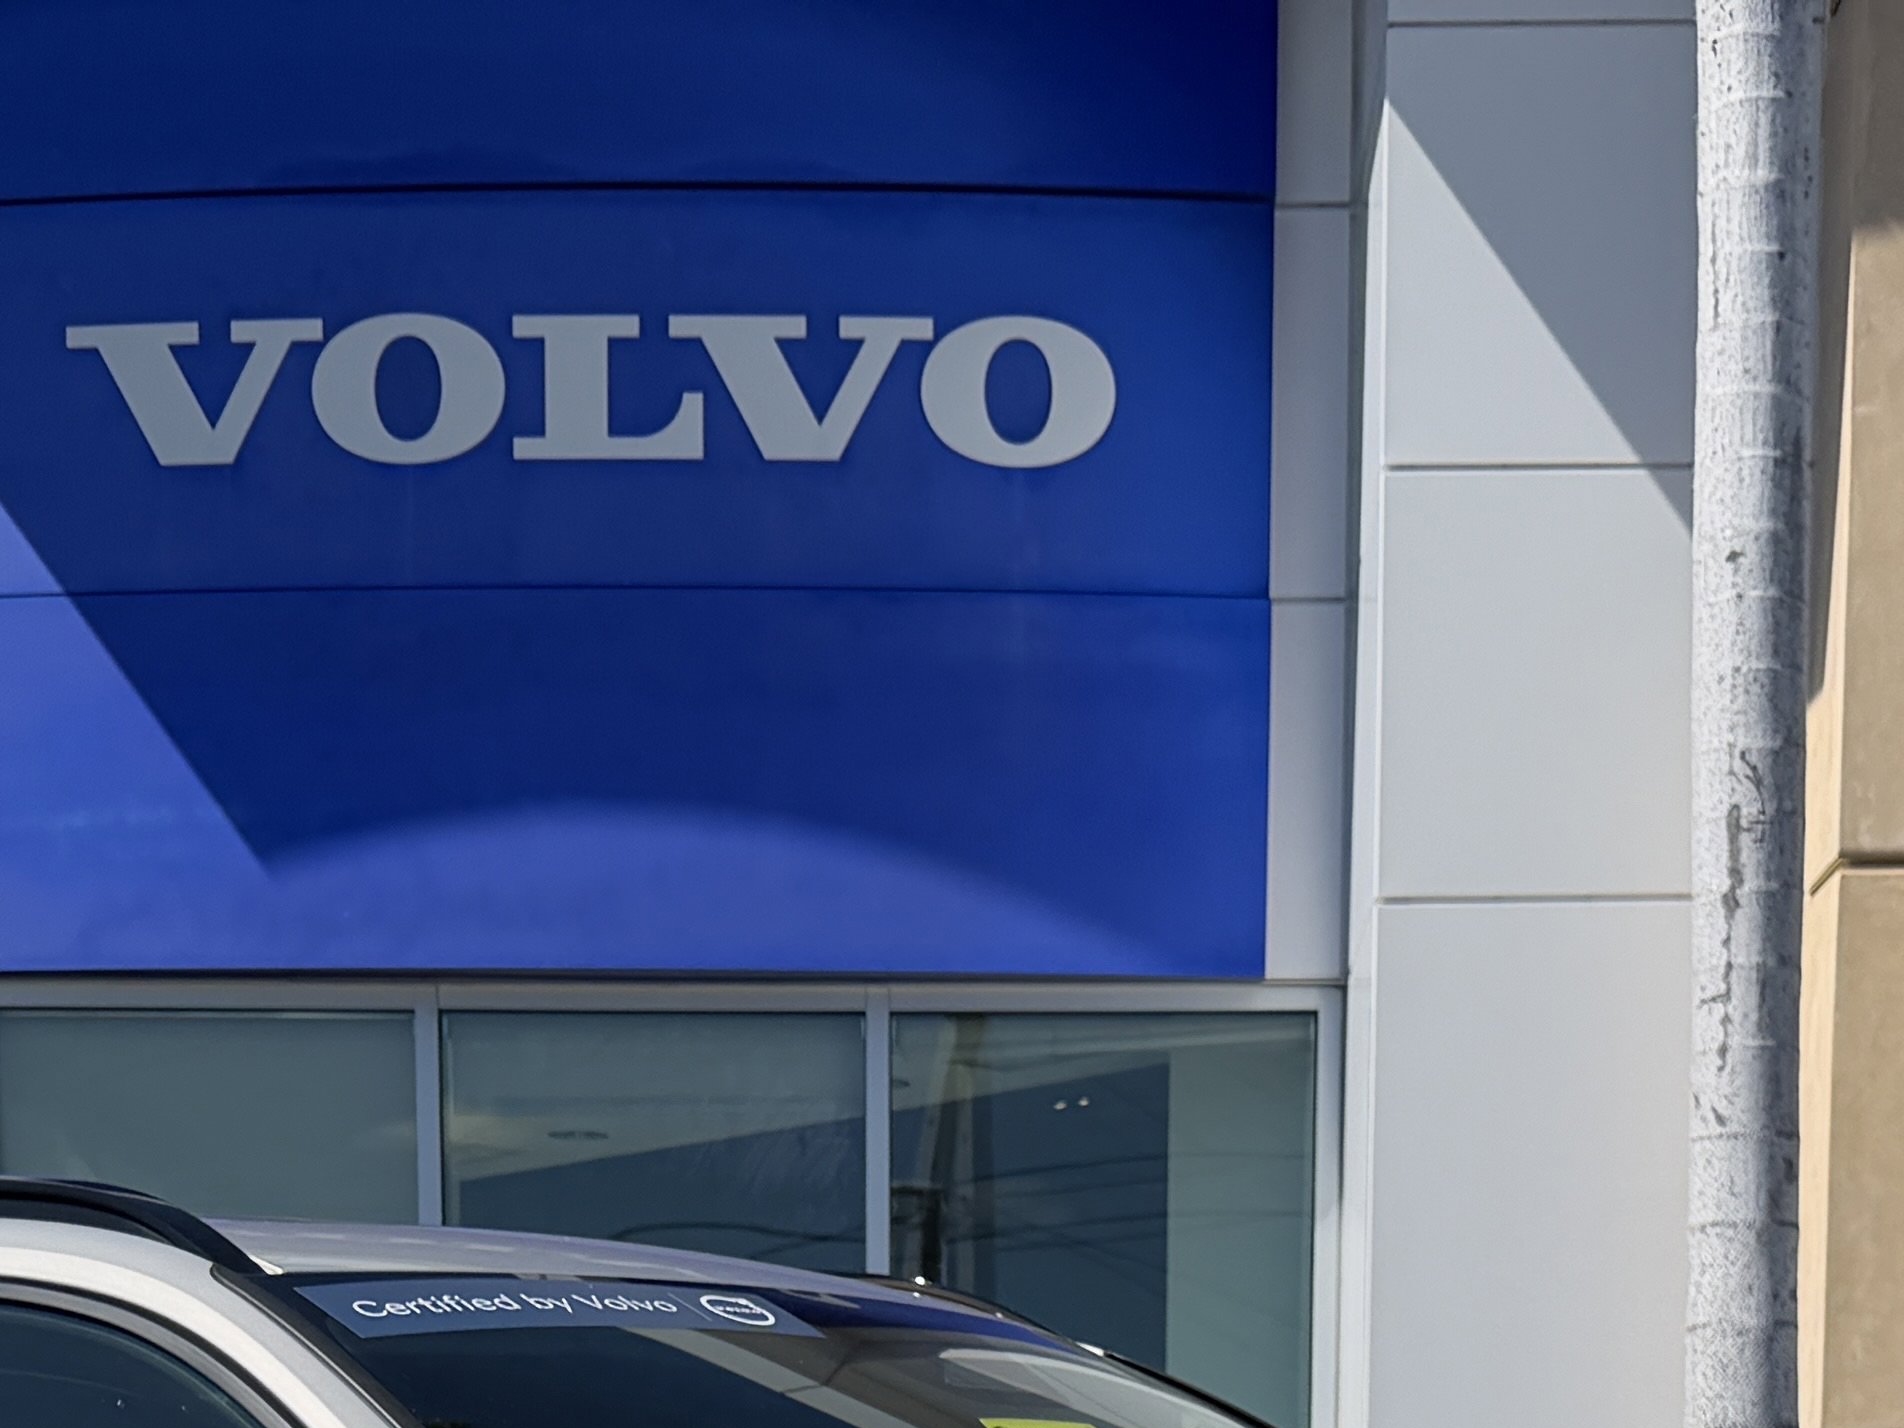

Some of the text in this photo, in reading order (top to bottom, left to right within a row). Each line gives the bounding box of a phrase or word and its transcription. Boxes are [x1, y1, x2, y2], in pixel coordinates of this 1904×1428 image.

[64, 312, 1118, 469] VOLVO
[351, 1293, 679, 1318] Certified by Volvo
